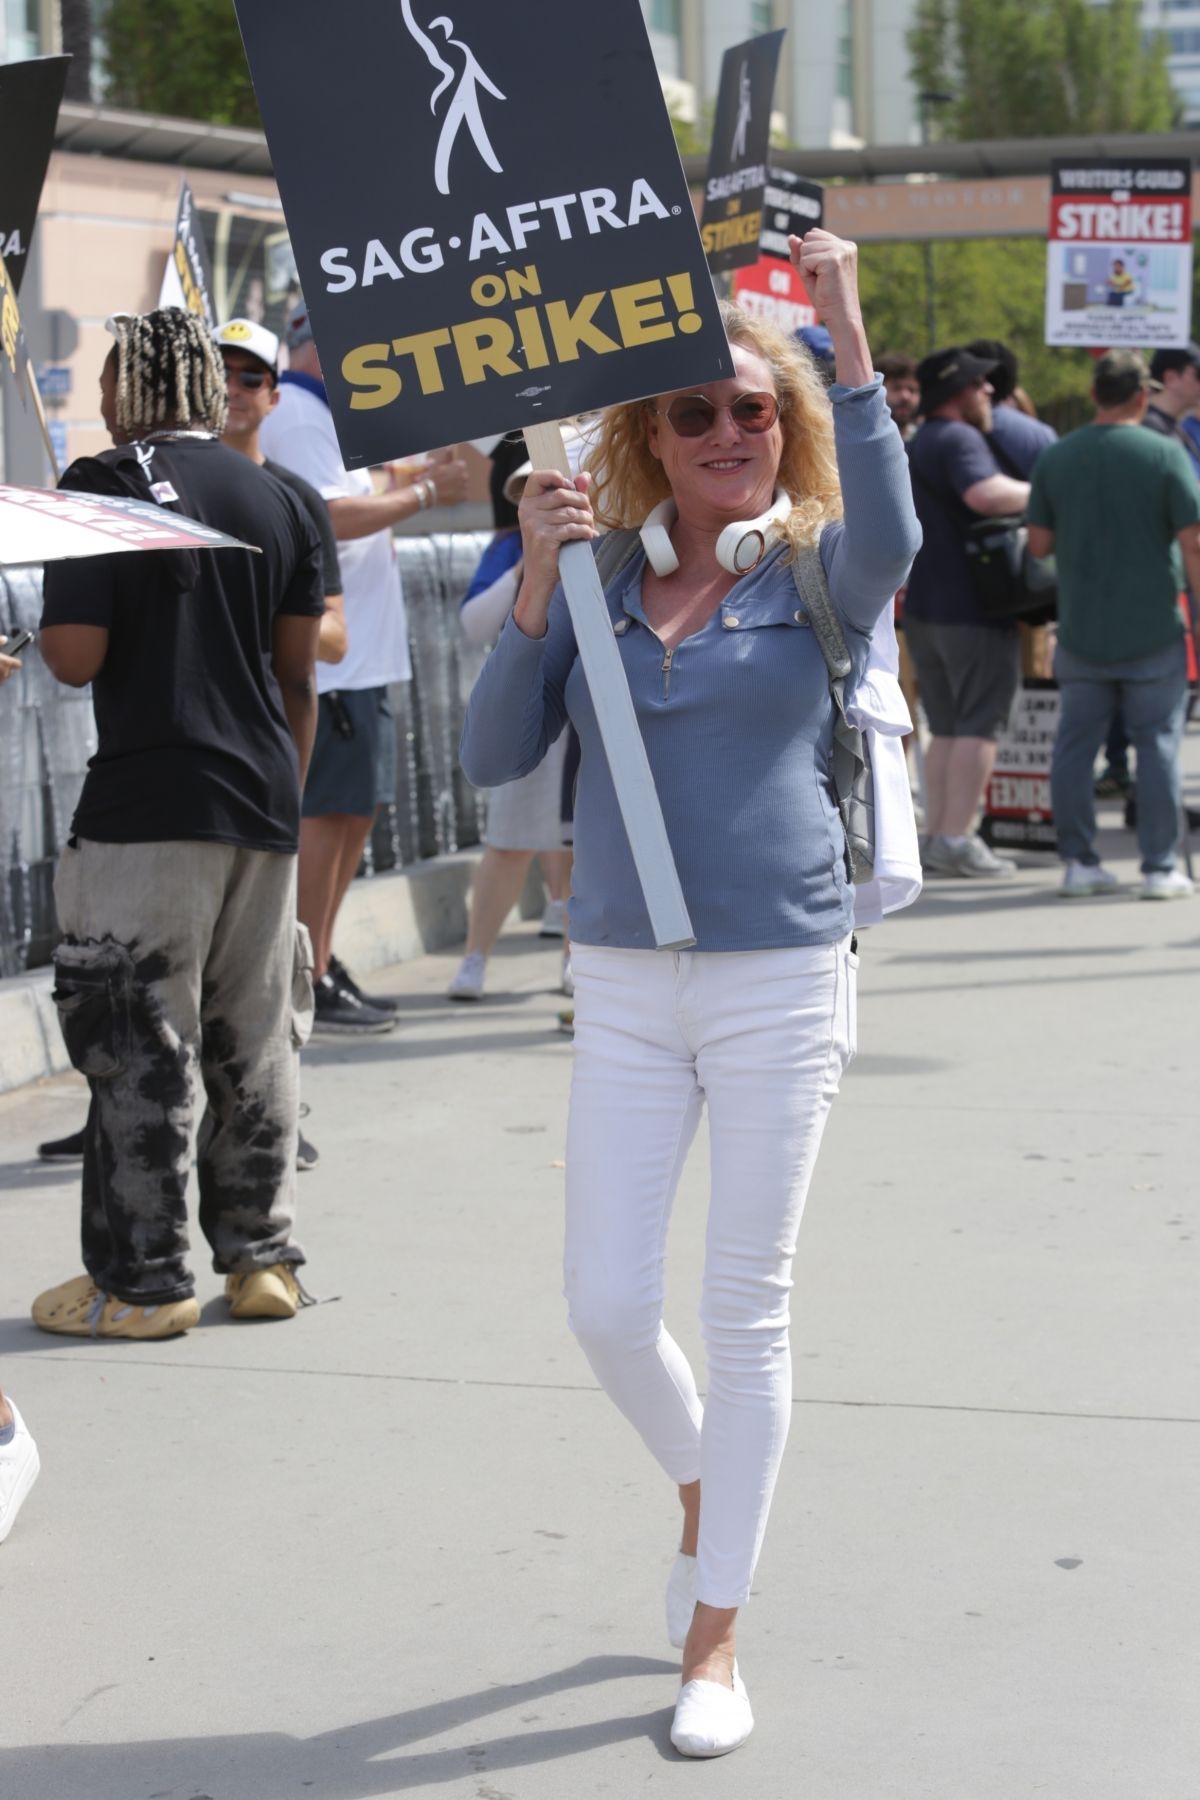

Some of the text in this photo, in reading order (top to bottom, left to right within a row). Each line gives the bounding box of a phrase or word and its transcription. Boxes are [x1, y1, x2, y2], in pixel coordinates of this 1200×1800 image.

[1059, 169, 1185, 189] WRITERS GUILD
[1057, 203, 1184, 240] STRIKE!
[470, 265, 542, 307] ON
[768, 268, 790, 295] ON
[341, 272, 702, 411] STRIKE!
[128, 507, 223, 539] GUILD
[991, 777, 1053, 812] RIKE!
